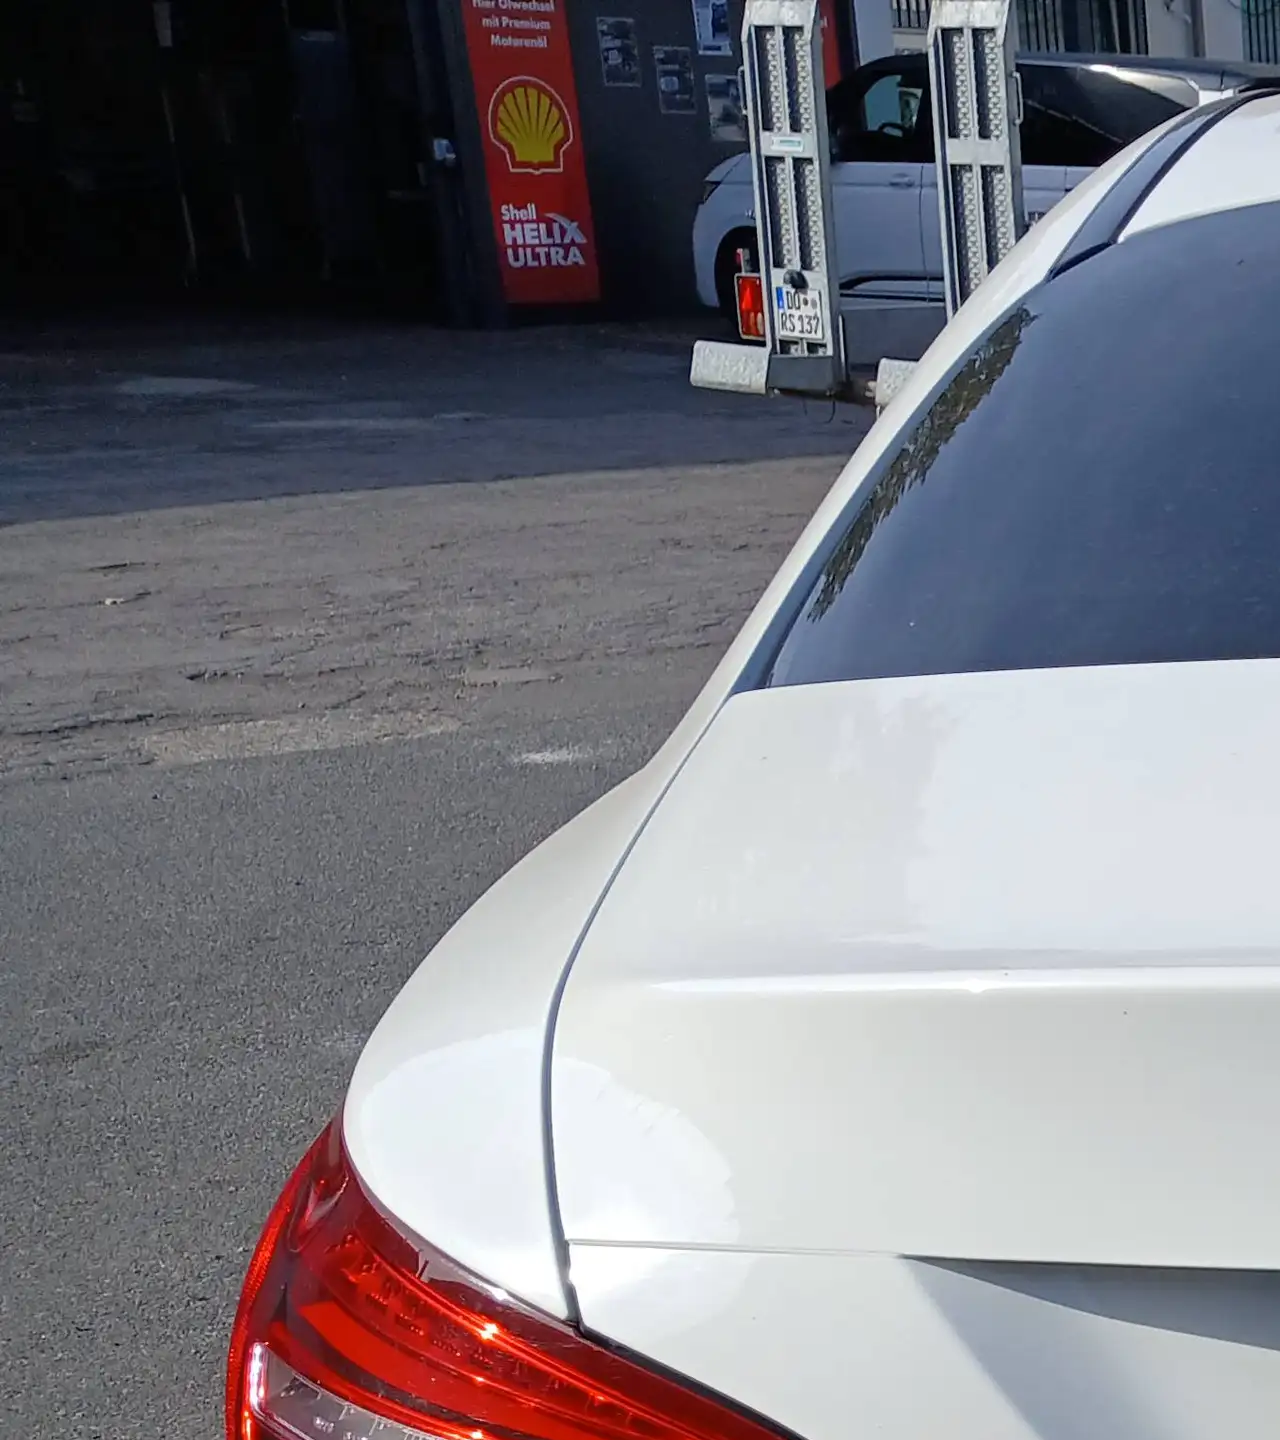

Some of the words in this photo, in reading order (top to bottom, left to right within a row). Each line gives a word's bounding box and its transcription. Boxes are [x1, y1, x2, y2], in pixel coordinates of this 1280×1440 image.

[482, 15, 499, 28] mit
[502, 16, 551, 30] Premium
[490, 34, 548, 48] Motorenöl
[501, 203, 537, 221] Shell
[502, 213, 588, 246] HELIX
[506, 246, 586, 268] ULTRA
[781, 312, 796, 334] RS
[798, 314, 820, 335] 137
